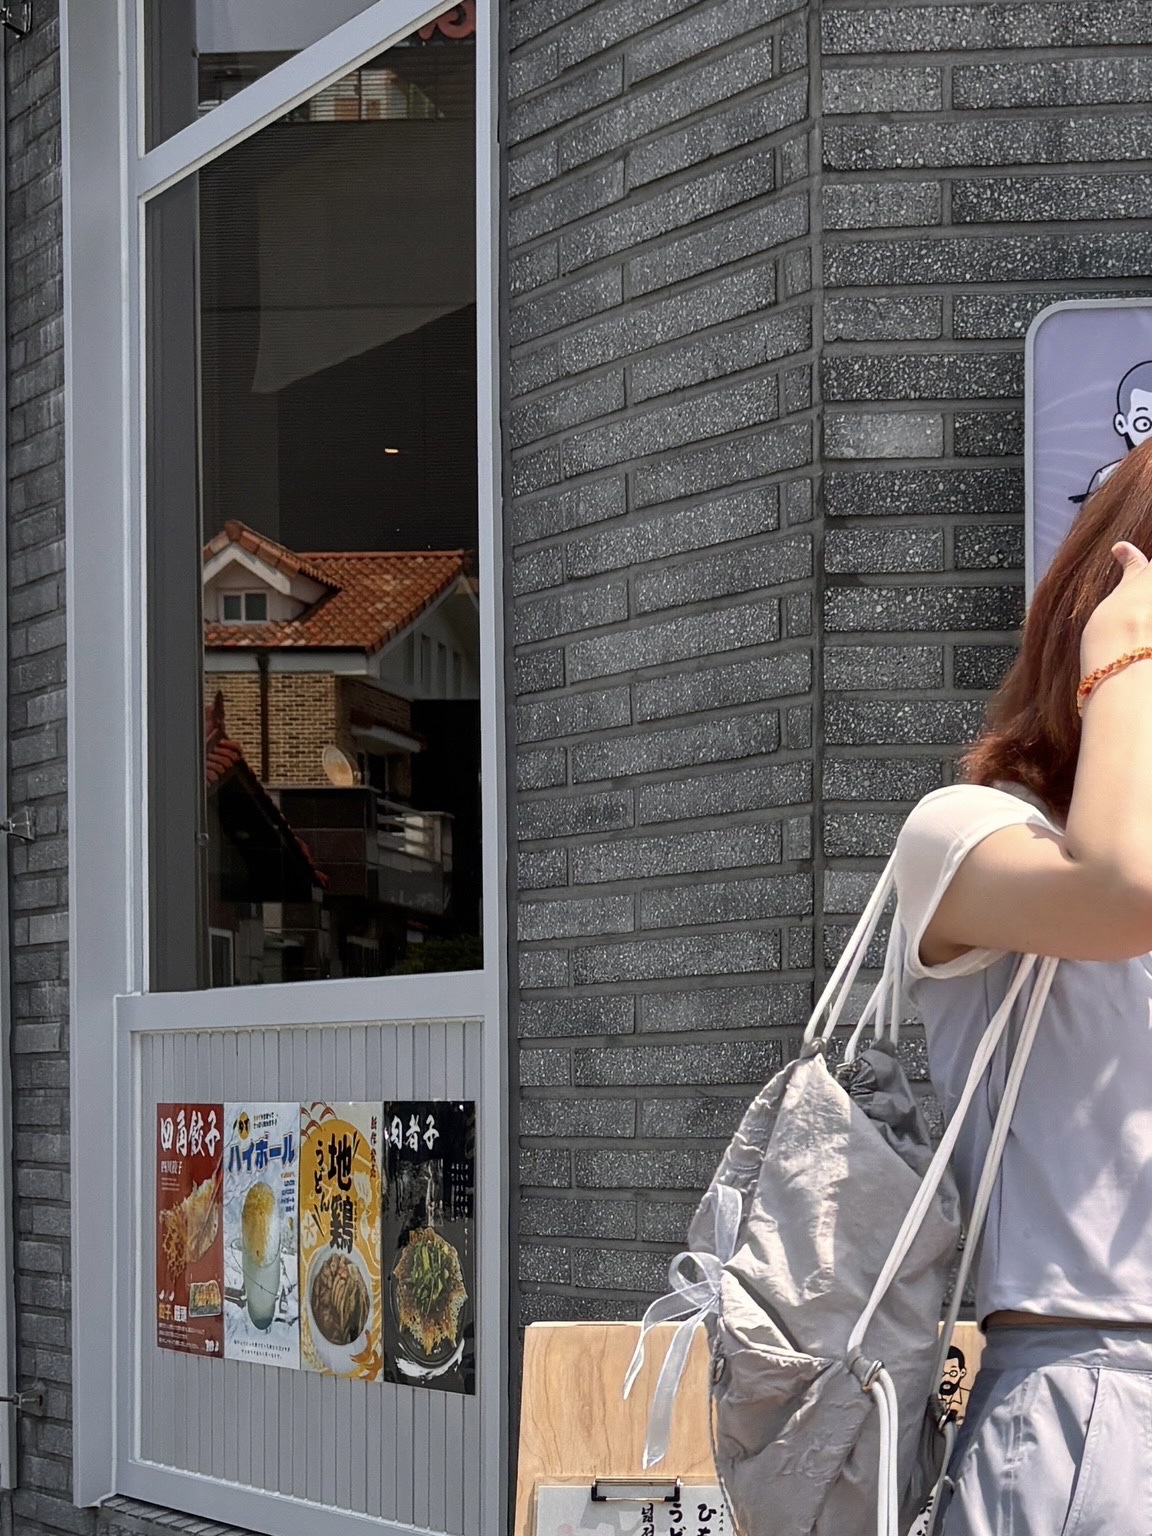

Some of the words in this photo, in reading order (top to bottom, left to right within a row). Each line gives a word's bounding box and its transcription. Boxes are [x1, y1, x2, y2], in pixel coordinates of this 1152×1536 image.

[228, 1131, 295, 1173] ハイボール
[314, 1139, 330, 1213] うどん
